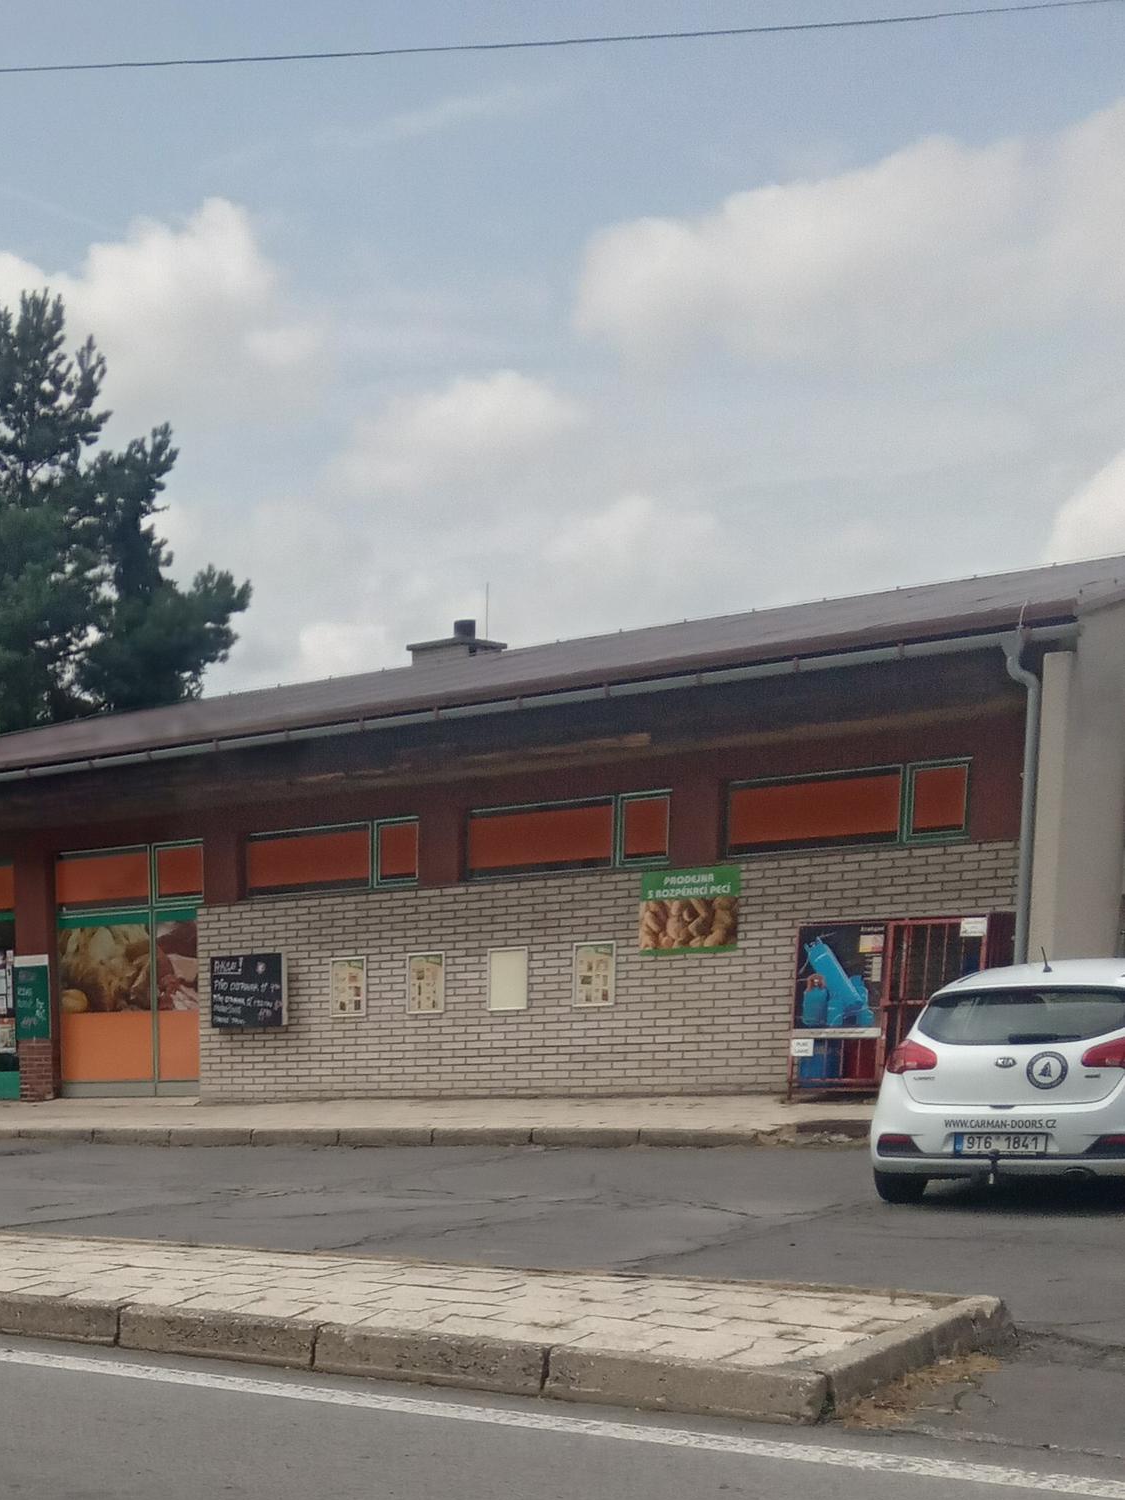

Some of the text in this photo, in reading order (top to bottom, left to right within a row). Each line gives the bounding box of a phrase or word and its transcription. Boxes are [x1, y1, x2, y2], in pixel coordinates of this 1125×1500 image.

[944, 1119, 1057, 1129] WWW.CARMAN-DOORS.CZ
[966, 1135, 1038, 1150] 9T6 1841
